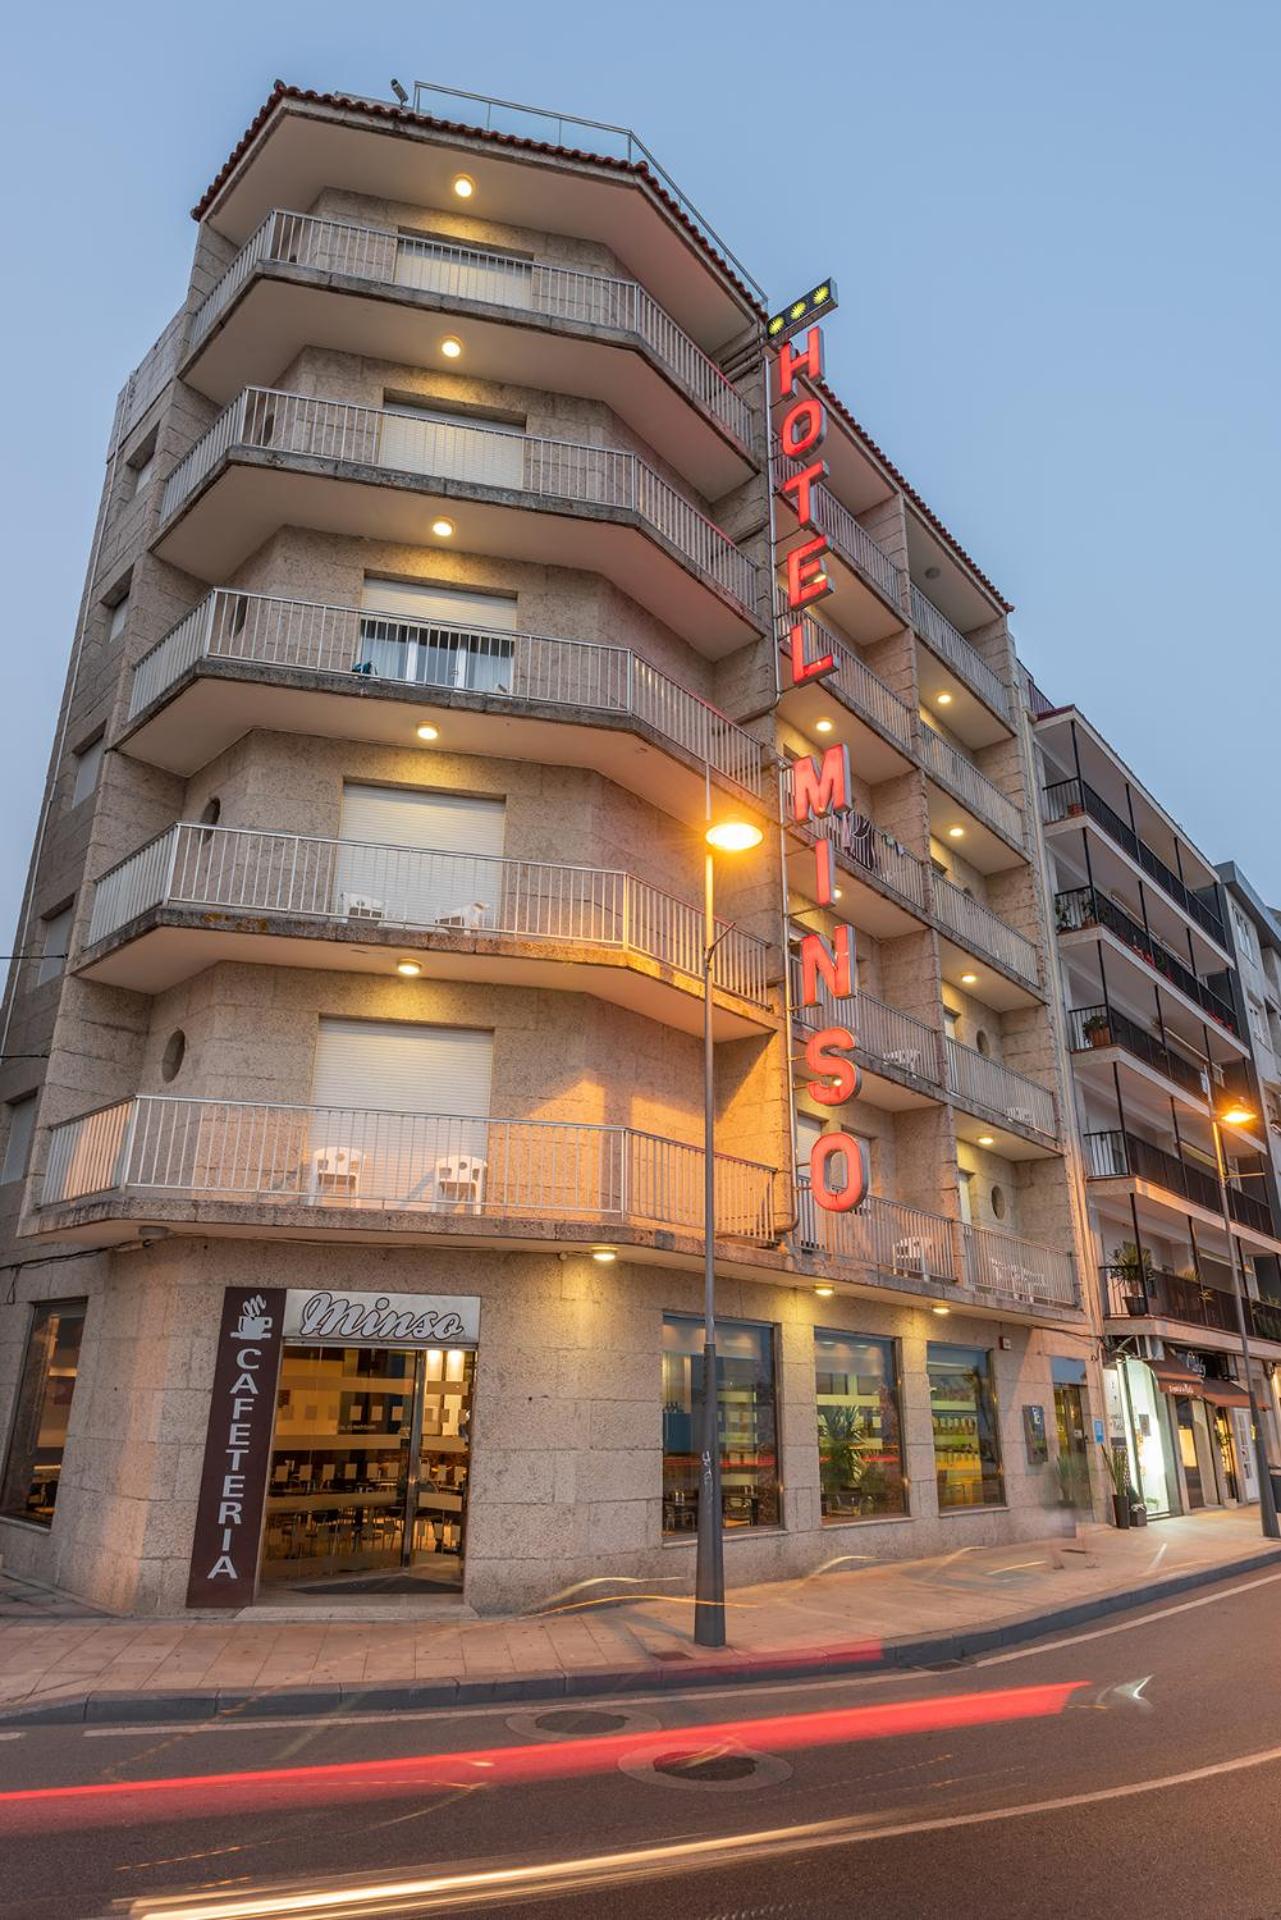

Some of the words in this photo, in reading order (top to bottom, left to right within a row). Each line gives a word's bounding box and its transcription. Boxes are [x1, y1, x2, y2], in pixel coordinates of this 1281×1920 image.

[779, 325, 840, 686] HOTEL
[792, 743, 868, 1213] MINSO
[206, 1348, 262, 1580] CAFETERIA
[300, 1292, 464, 1341] Minso
